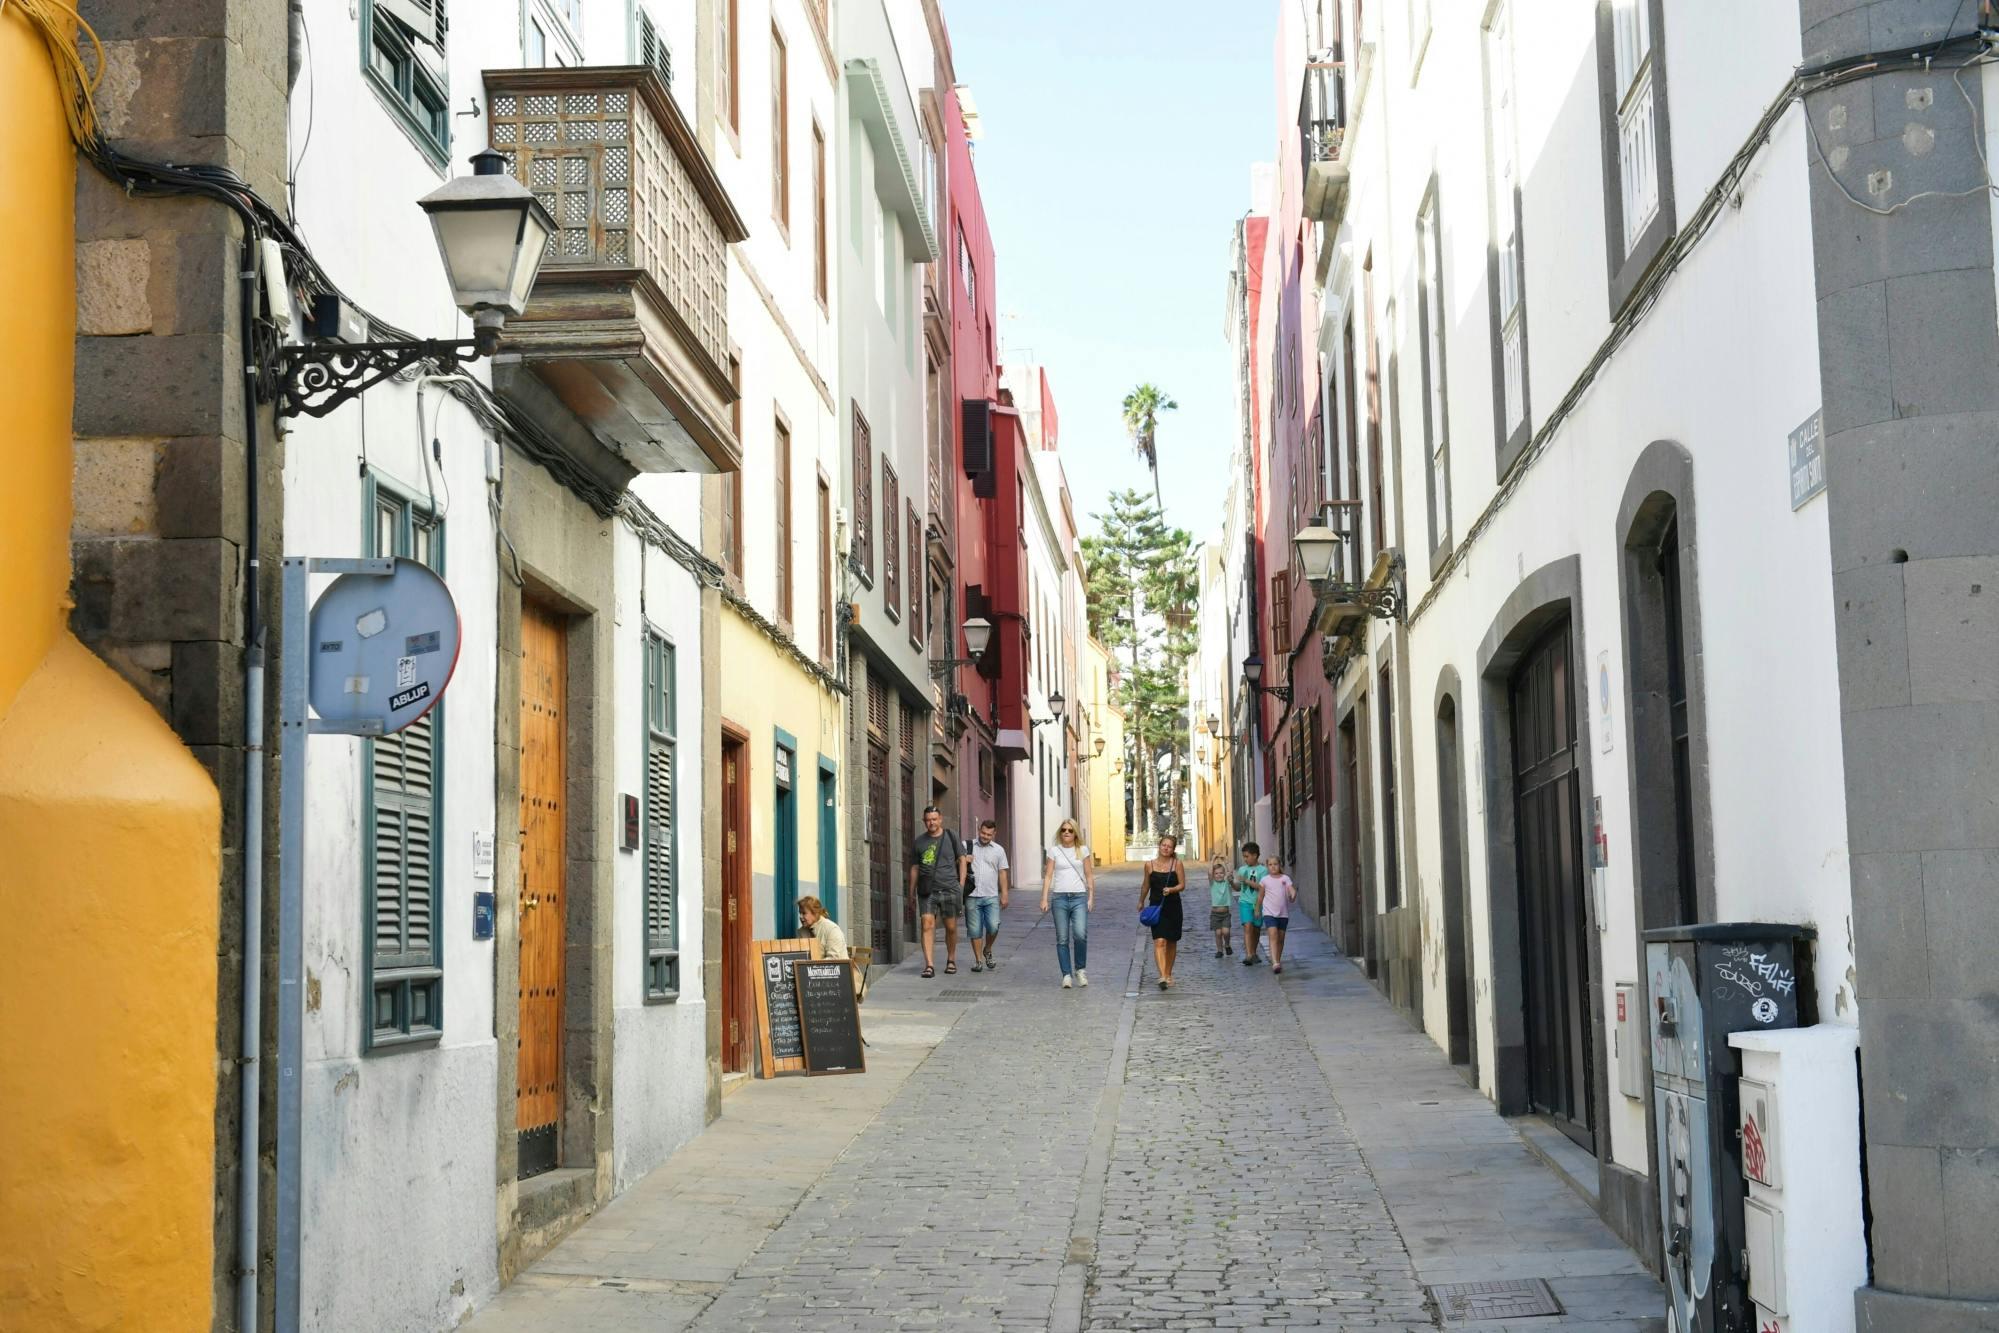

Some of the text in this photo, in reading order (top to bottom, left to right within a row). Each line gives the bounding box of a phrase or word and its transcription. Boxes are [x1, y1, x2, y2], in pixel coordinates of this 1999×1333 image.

[1799, 418, 1819, 448] CALLE
[1805, 445, 1815, 457] DEL
[392, 685, 428, 709] ABLUP
